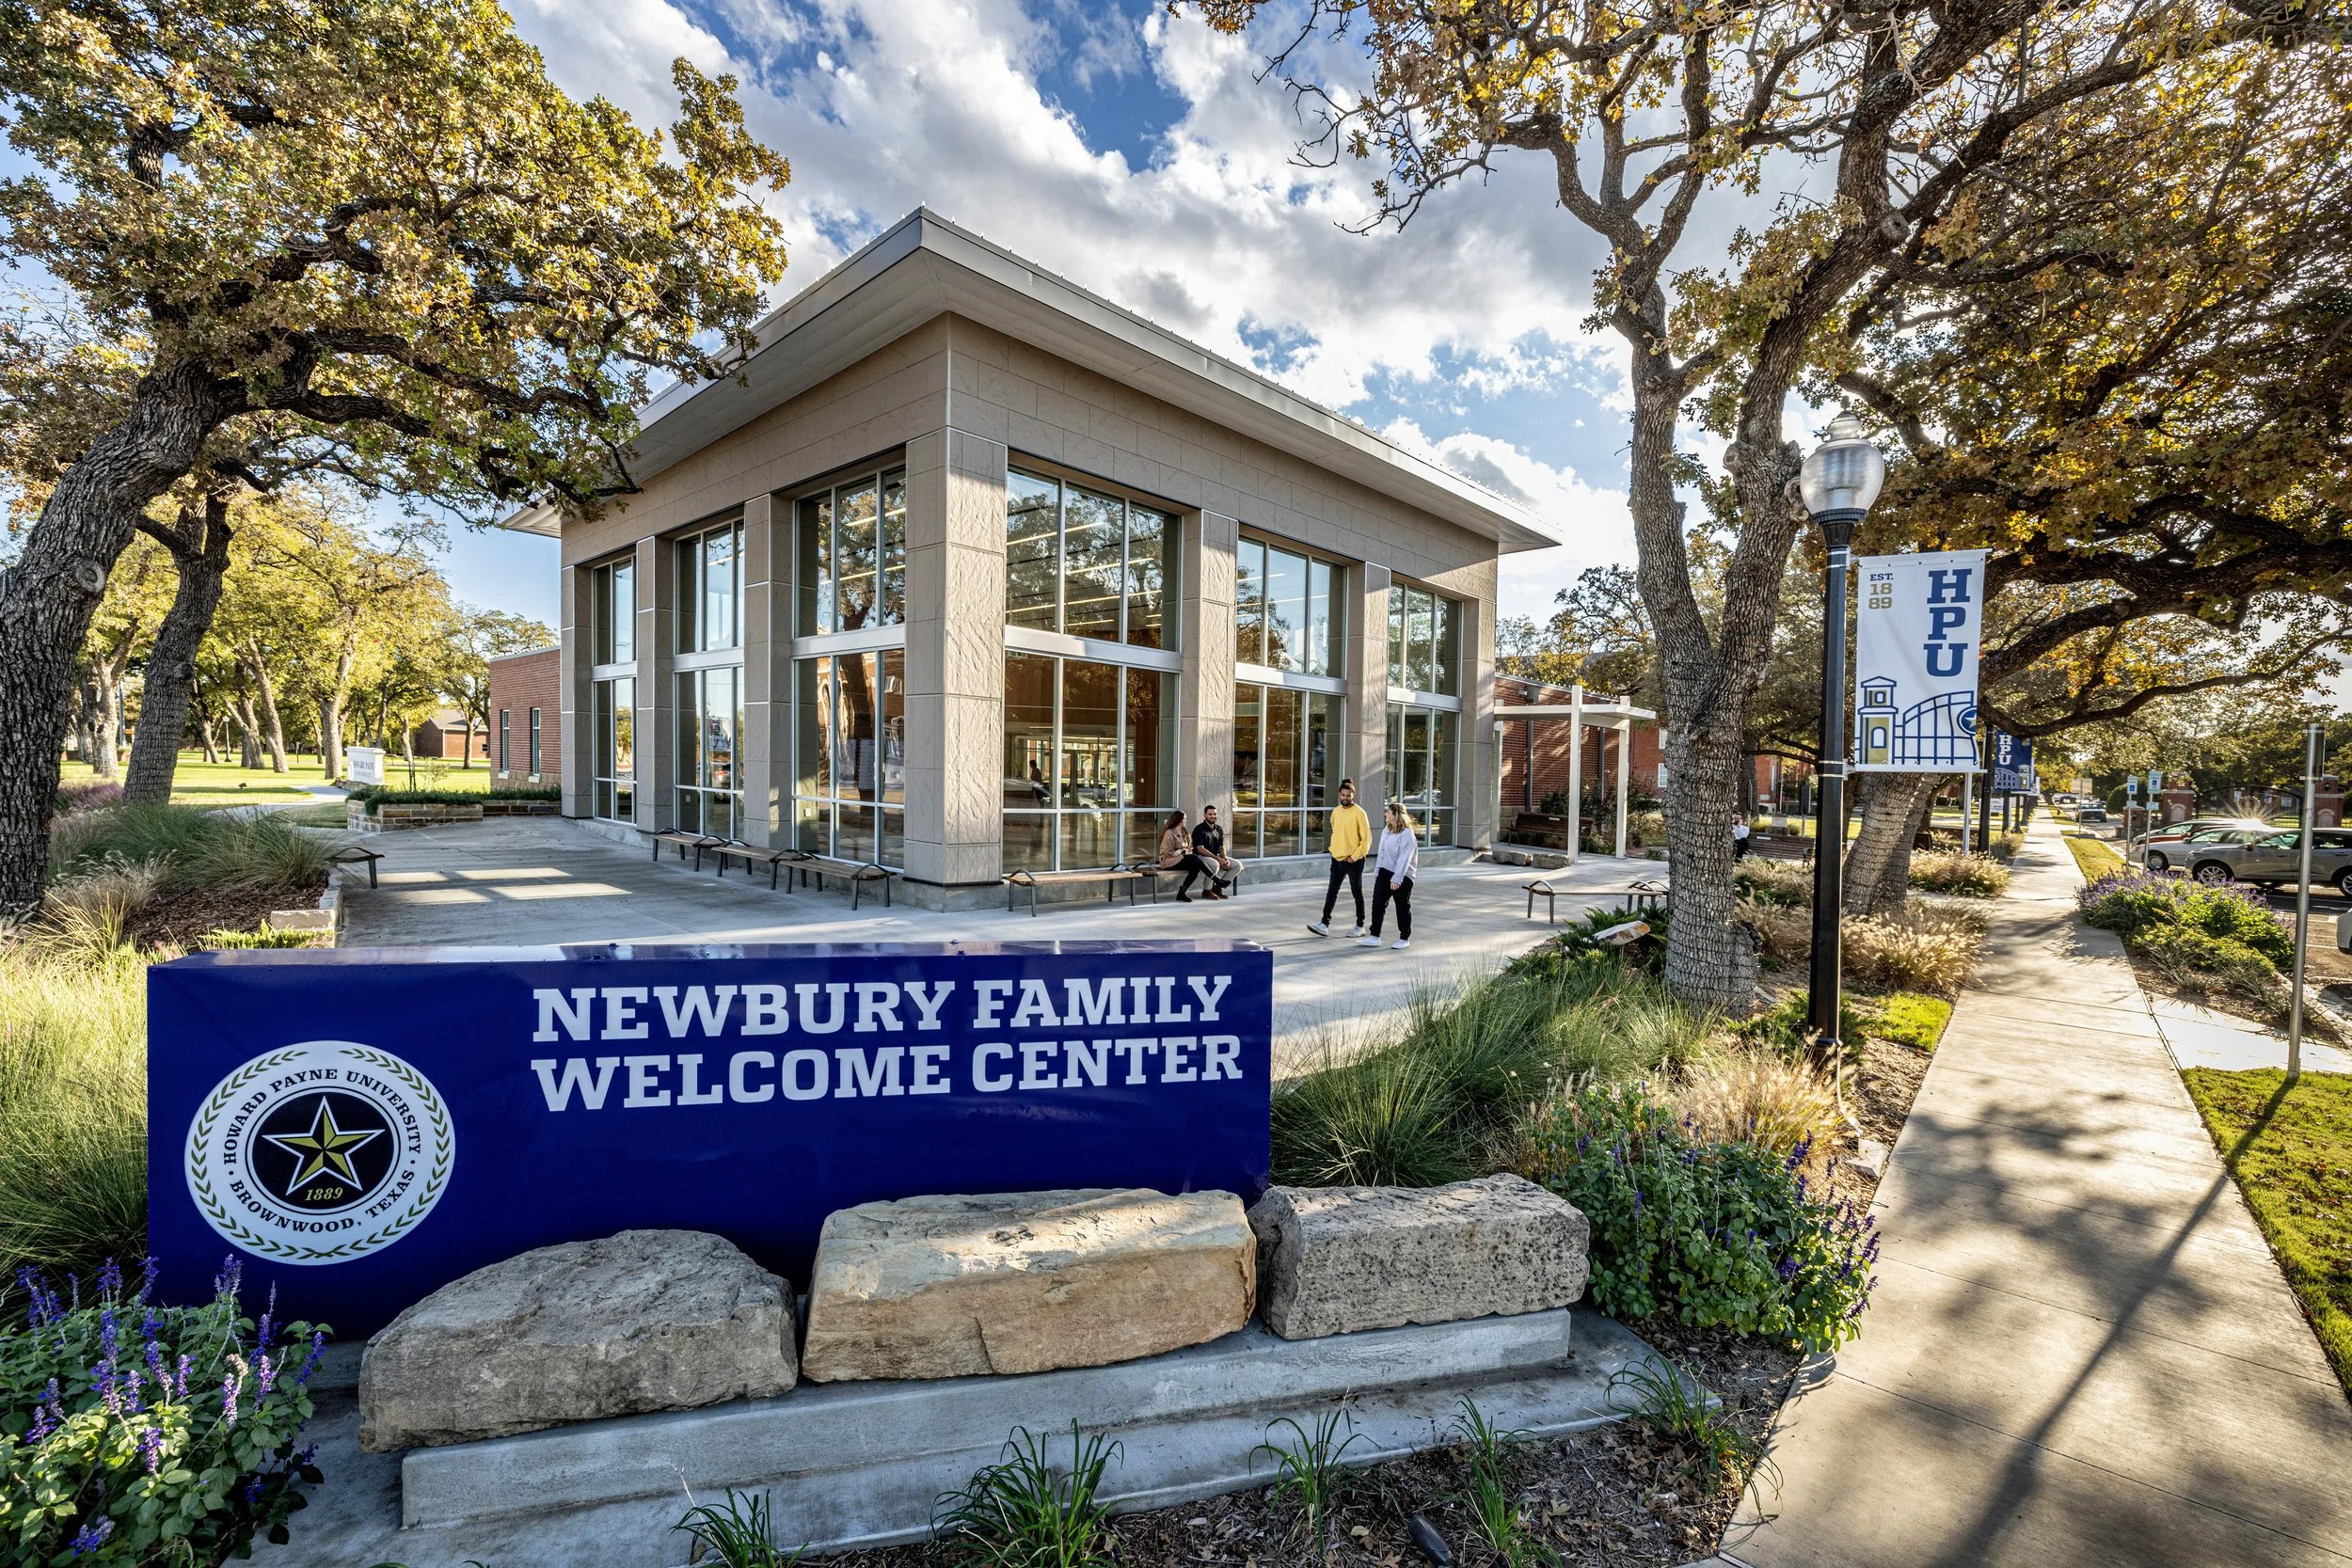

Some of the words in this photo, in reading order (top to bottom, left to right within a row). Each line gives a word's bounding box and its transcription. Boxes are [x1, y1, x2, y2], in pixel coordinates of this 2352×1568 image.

[1869, 573, 1894, 581] EST.
[1869, 582, 1893, 595] 18
[1868, 596, 1893, 610] 89
[1923, 568, 1972, 677] HPU
[1998, 735, 2012, 765] HPU
[532, 981, 955, 1042] NEWBURY
[973, 975, 1232, 1028] FAMILY
[531, 1045, 951, 1112] WELCOME
[972, 1035, 1243, 1092] CENTER
[224, 1092, 267, 1165] HOWARD
[269, 1069, 338, 1093] PAYNE
[346, 1070, 421, 1154] UNIVERSITY
[230, 1180, 362, 1233] BROWNWOOD,
[365, 1169, 415, 1218] TEXAS
[304, 1187, 343, 1201] 1889
